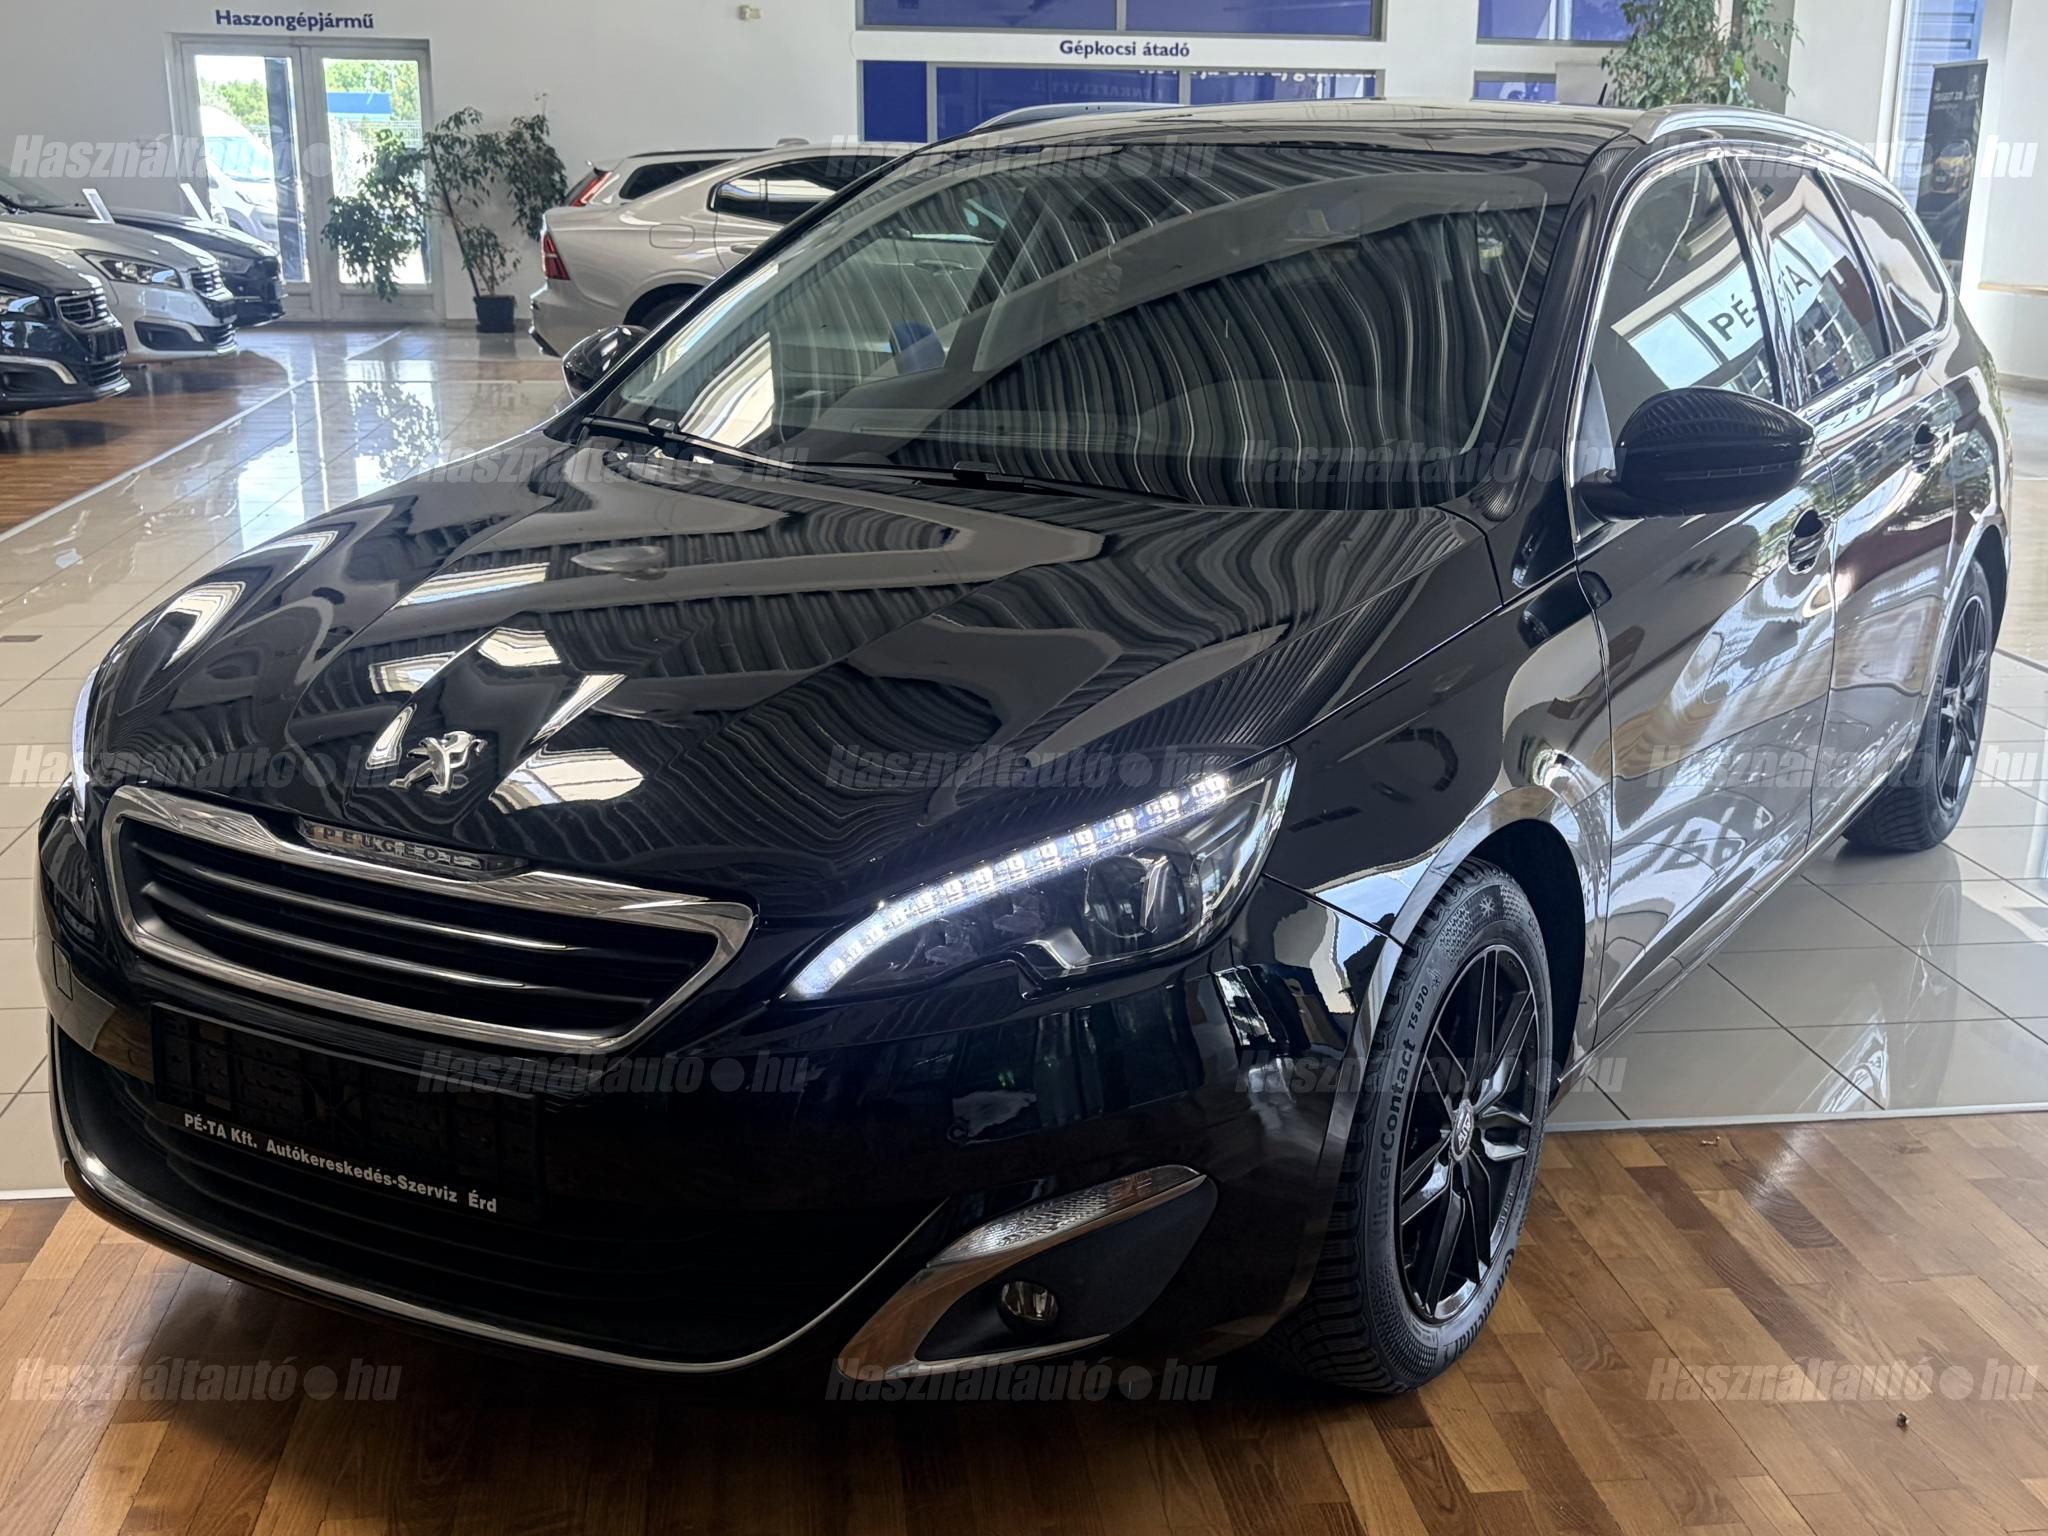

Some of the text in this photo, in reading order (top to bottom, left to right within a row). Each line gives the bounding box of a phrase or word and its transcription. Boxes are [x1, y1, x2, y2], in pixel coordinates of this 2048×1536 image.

[215, 9, 374, 32] Haszongépjármű
[1059, 39, 1191, 59] Gépkocsi átadó
[184, 1113, 497, 1214] PÉ-TA Kft. Autókereskedés-Szerviz Érd
